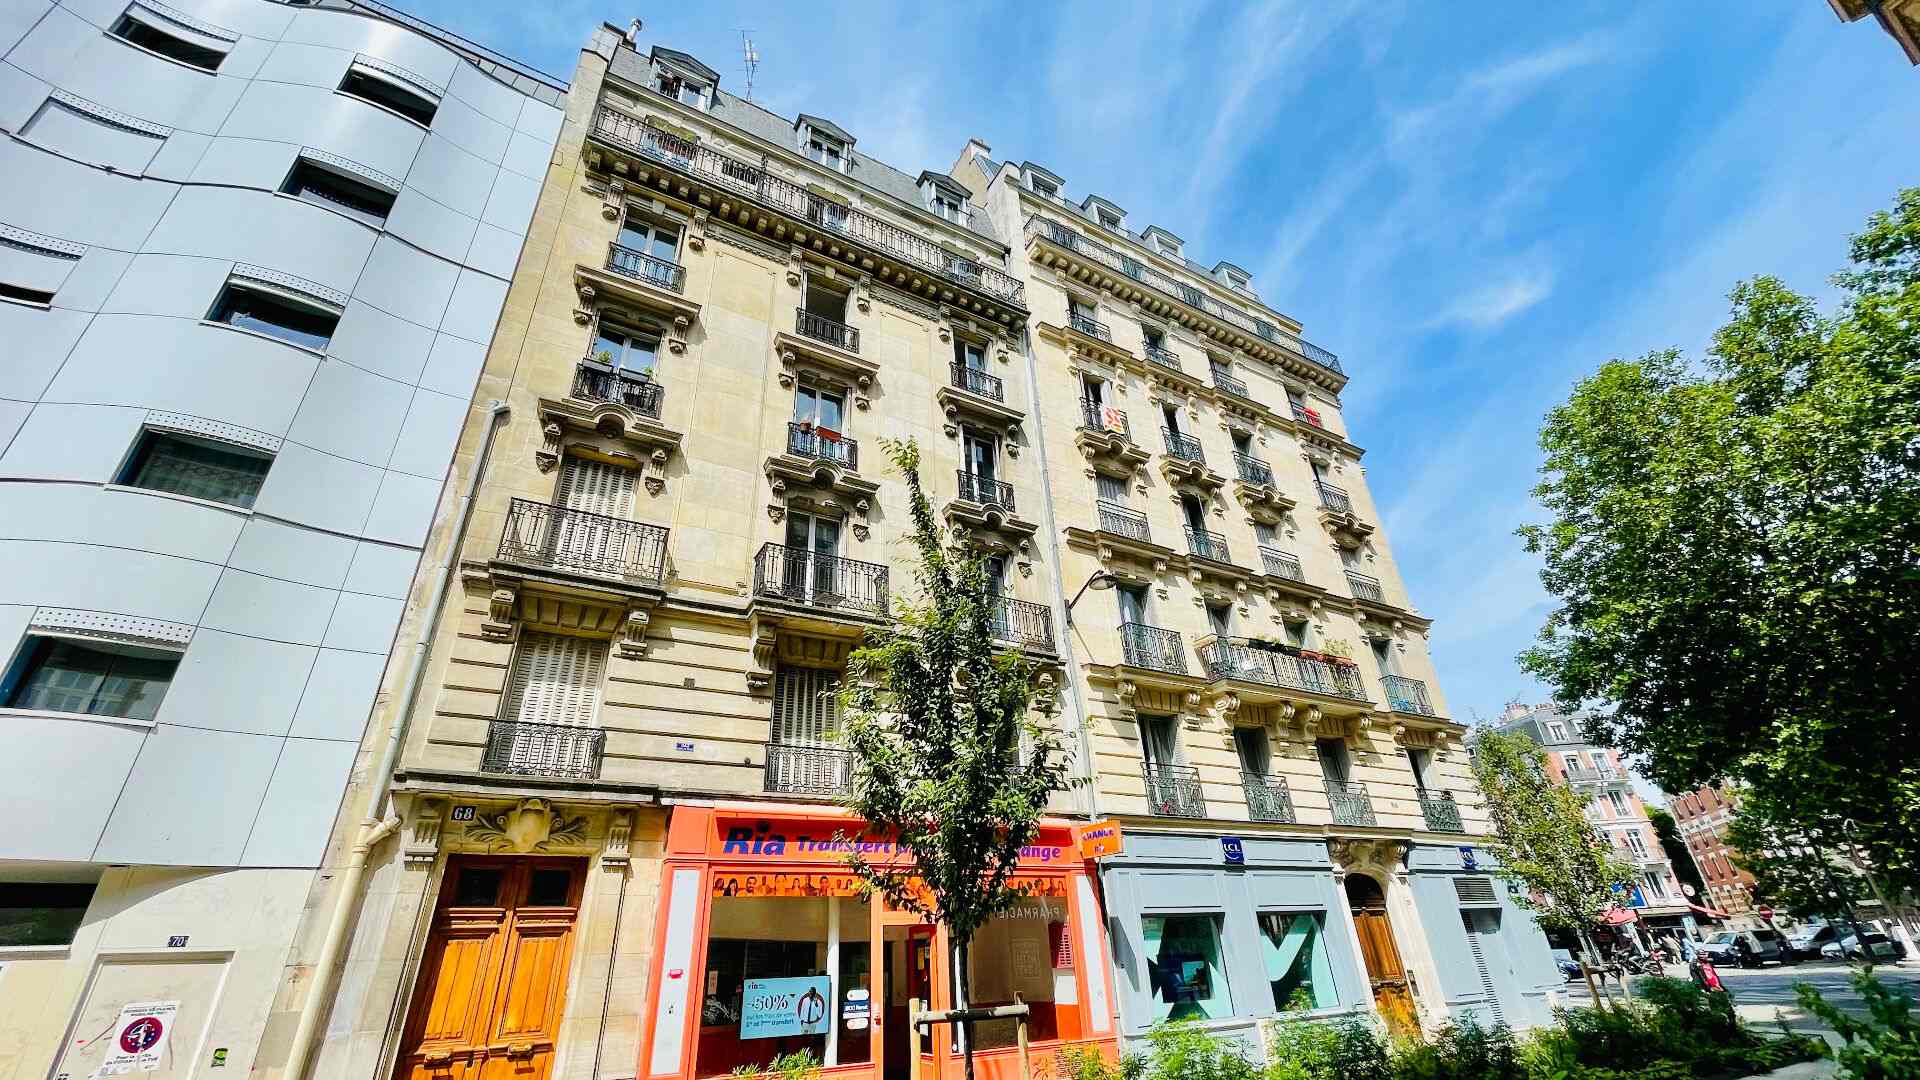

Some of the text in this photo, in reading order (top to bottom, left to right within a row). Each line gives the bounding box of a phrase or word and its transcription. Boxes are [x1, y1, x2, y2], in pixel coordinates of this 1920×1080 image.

[454, 807, 473, 820] 68
[723, 820, 786, 856] Ria
[1223, 843, 1241, 852] LCL
[172, 936, 185, 947] 70
